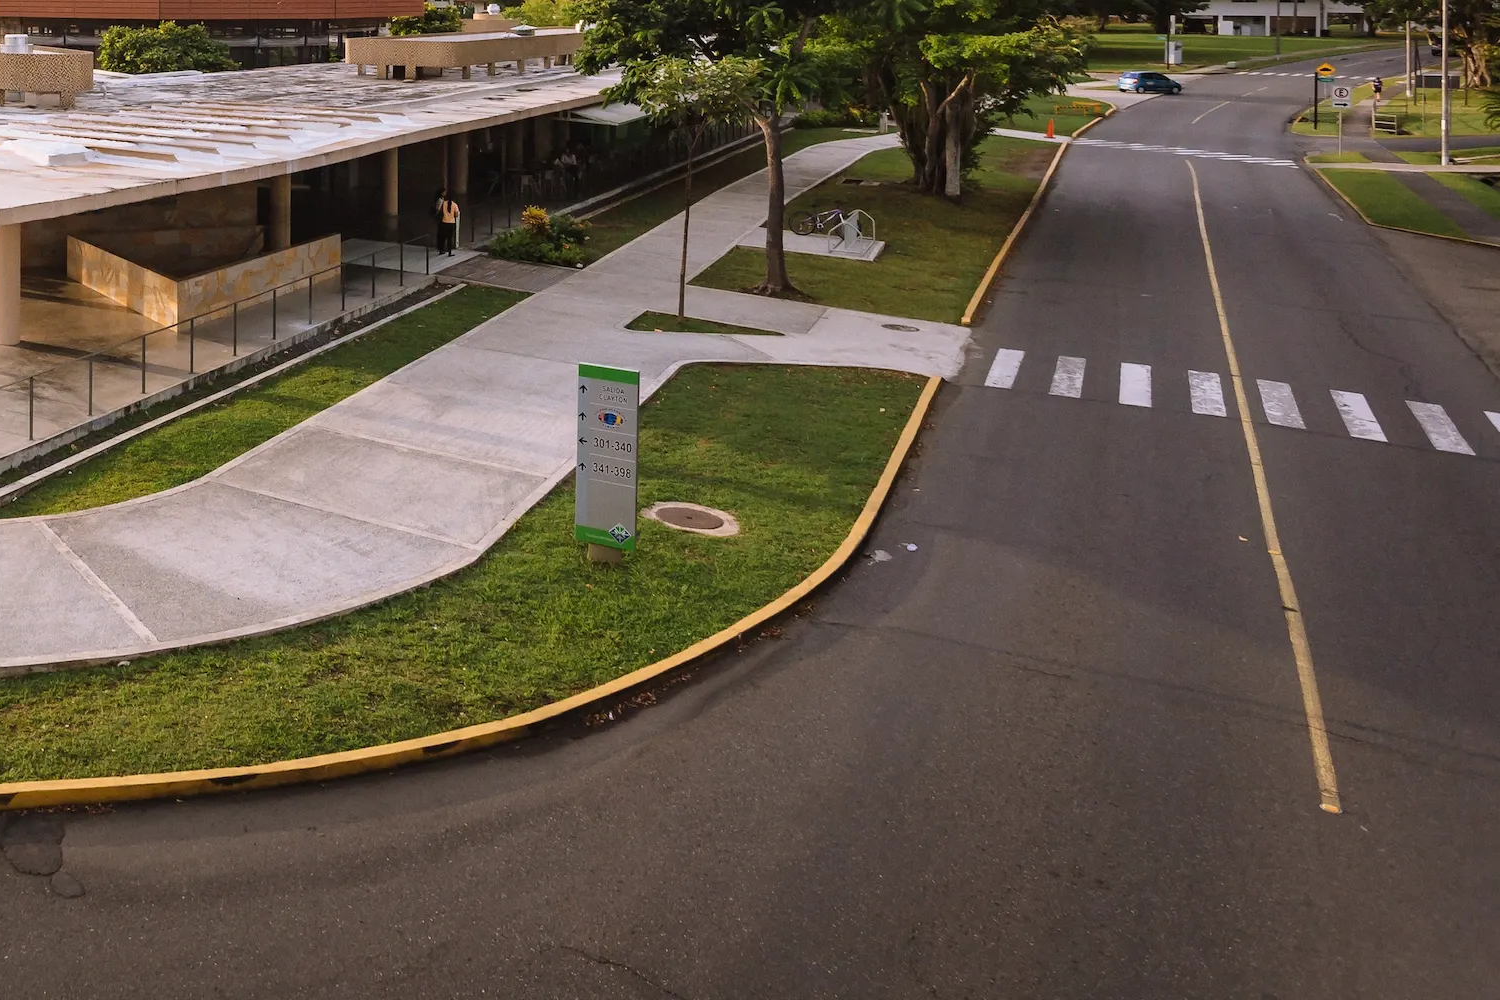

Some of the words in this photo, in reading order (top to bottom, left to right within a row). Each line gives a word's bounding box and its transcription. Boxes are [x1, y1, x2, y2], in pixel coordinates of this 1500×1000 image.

[602, 385, 625, 394] SALIDA
[598, 394, 628, 403] CLAYTON
[593, 437, 632, 453] 301-340
[592, 462, 632, 478] 341-398
